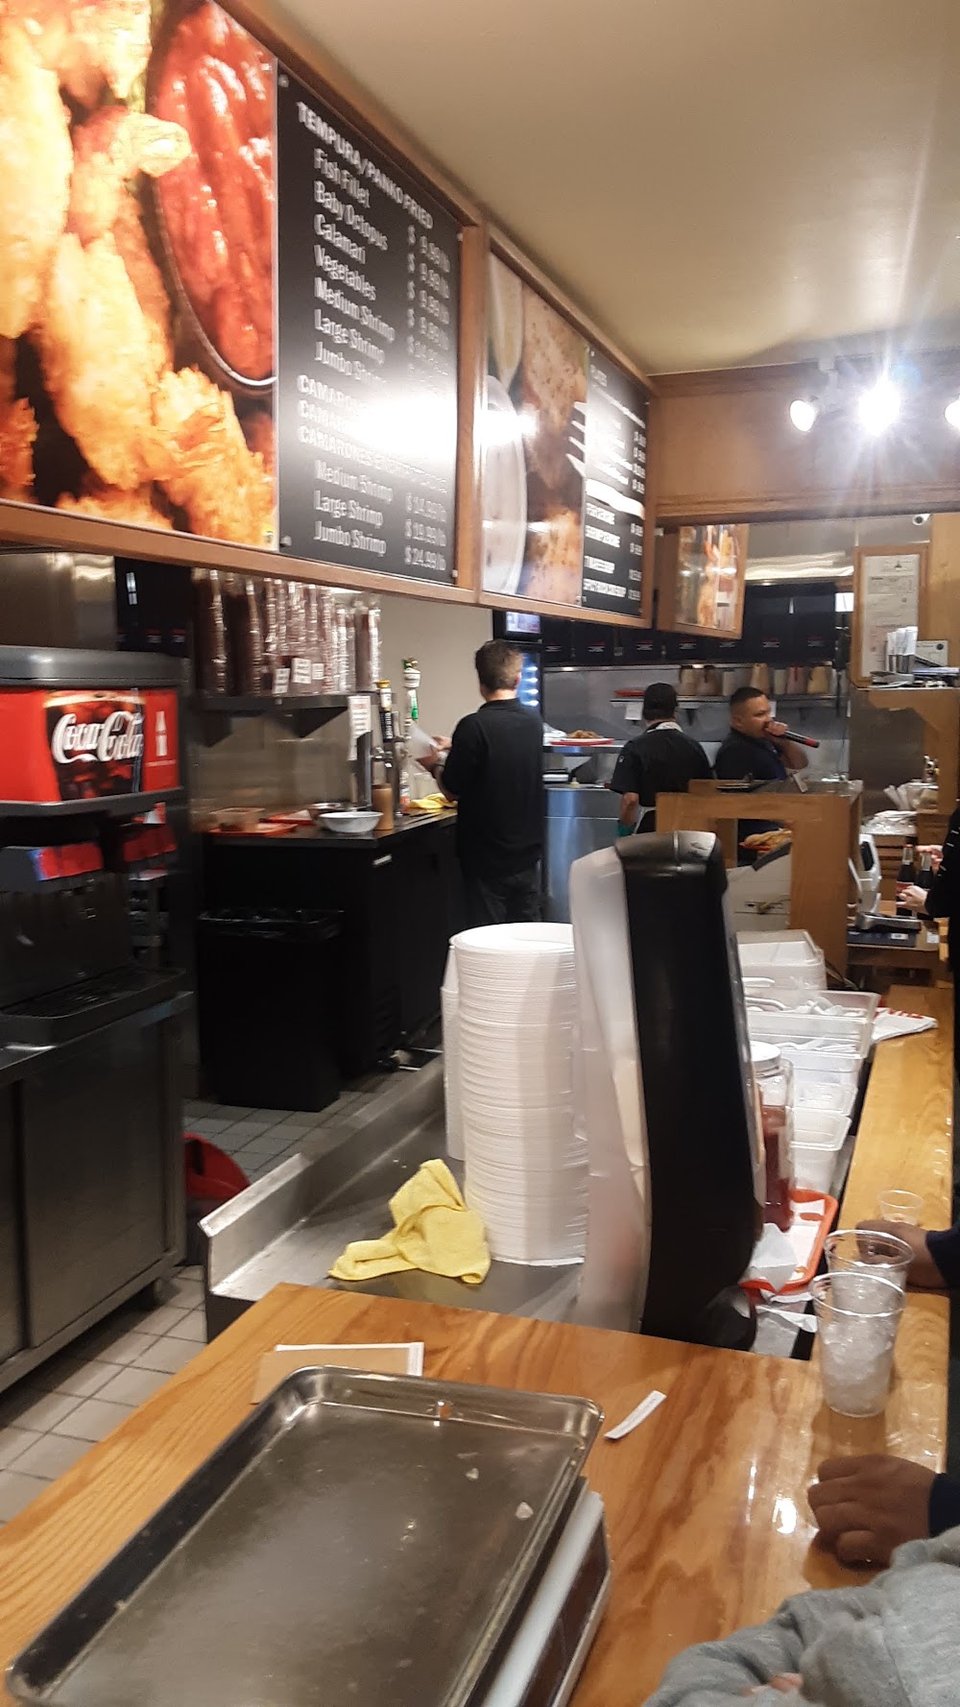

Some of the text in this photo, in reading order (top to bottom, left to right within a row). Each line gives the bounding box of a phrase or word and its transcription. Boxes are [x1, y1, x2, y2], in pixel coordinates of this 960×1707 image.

[297, 101, 433, 230] TEMPURA/PANKO FRIED
[314, 148, 370, 208] Fish Fillet
[314, 181, 388, 250] Baby Octopus
[314, 214, 366, 264] Calamari
[407, 224, 416, 245] $
[314, 245, 376, 301] Vegetables
[407, 253, 415, 274] $
[314, 277, 396, 344] Medium Shrimp
[407, 280, 415, 300] $
[314, 309, 349, 344] Large
[350, 328, 386, 365] Shrimp
[314, 341, 352, 376] Jumbo
[315, 459, 359, 491] Medium
[360, 474, 393, 504] Shrimp
[314, 489, 384, 529] Large Shrimp
[313, 520, 387, 557] Jumbo Shrimp
